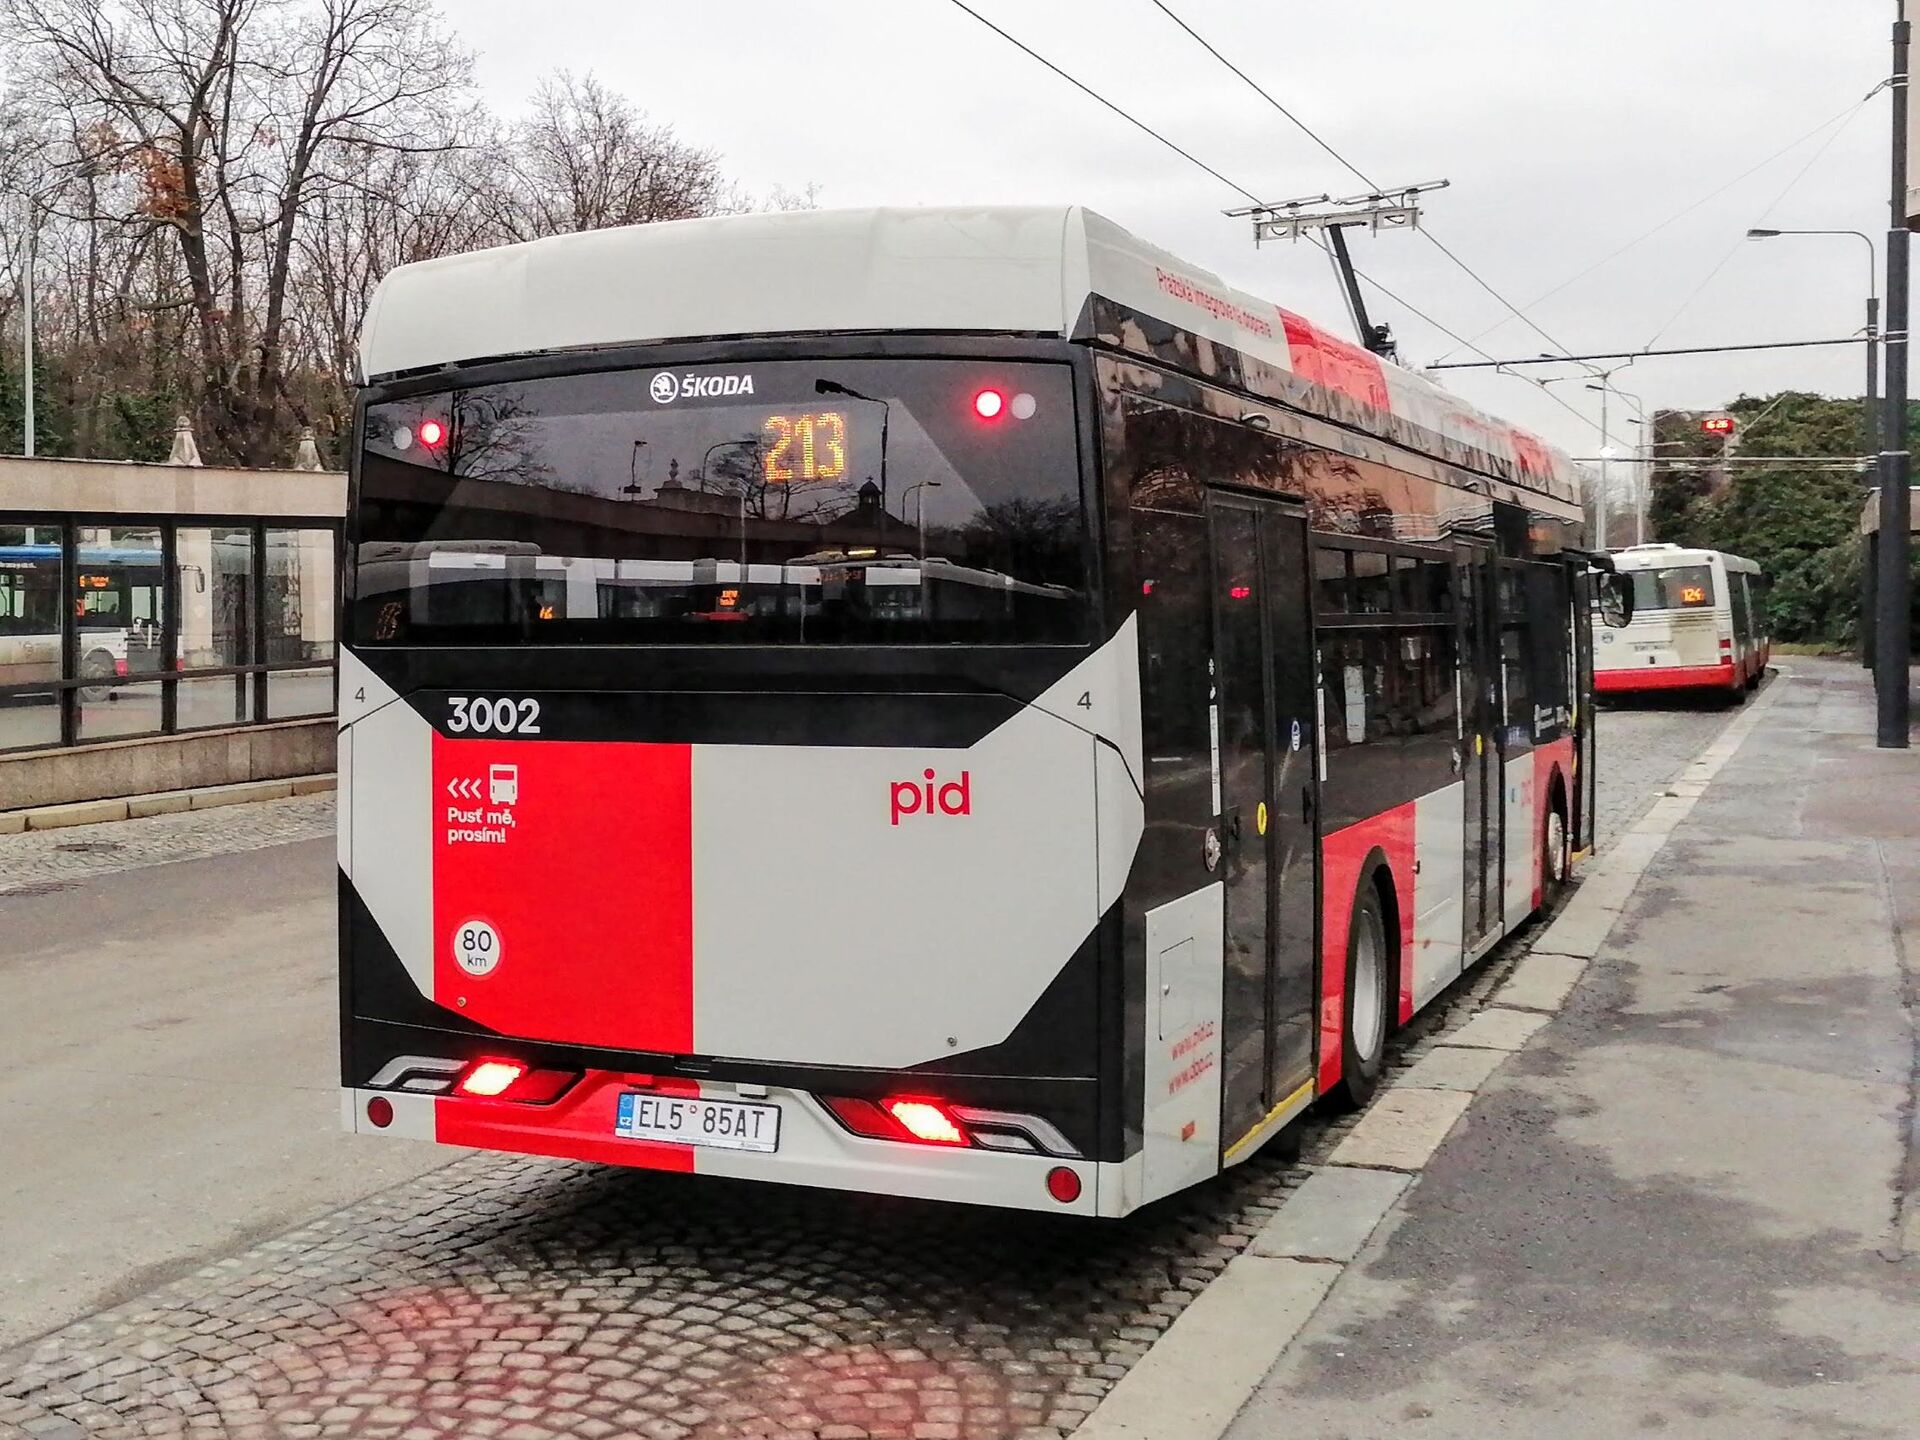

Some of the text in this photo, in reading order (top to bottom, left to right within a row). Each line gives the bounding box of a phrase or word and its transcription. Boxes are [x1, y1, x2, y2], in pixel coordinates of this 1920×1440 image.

[681, 373, 755, 398] ŠKODA
[764, 411, 845, 481] 213
[355, 686, 367, 703] 4
[1077, 690, 1092, 710] 4
[447, 697, 541, 734] 3002
[890, 768, 971, 826] pid
[447, 806, 517, 829] Pusť mě,
[447, 826, 507, 846] prosím!
[462, 928, 492, 952] 80
[467, 953, 488, 968] km
[638, 1100, 766, 1139] EL5 85AT
